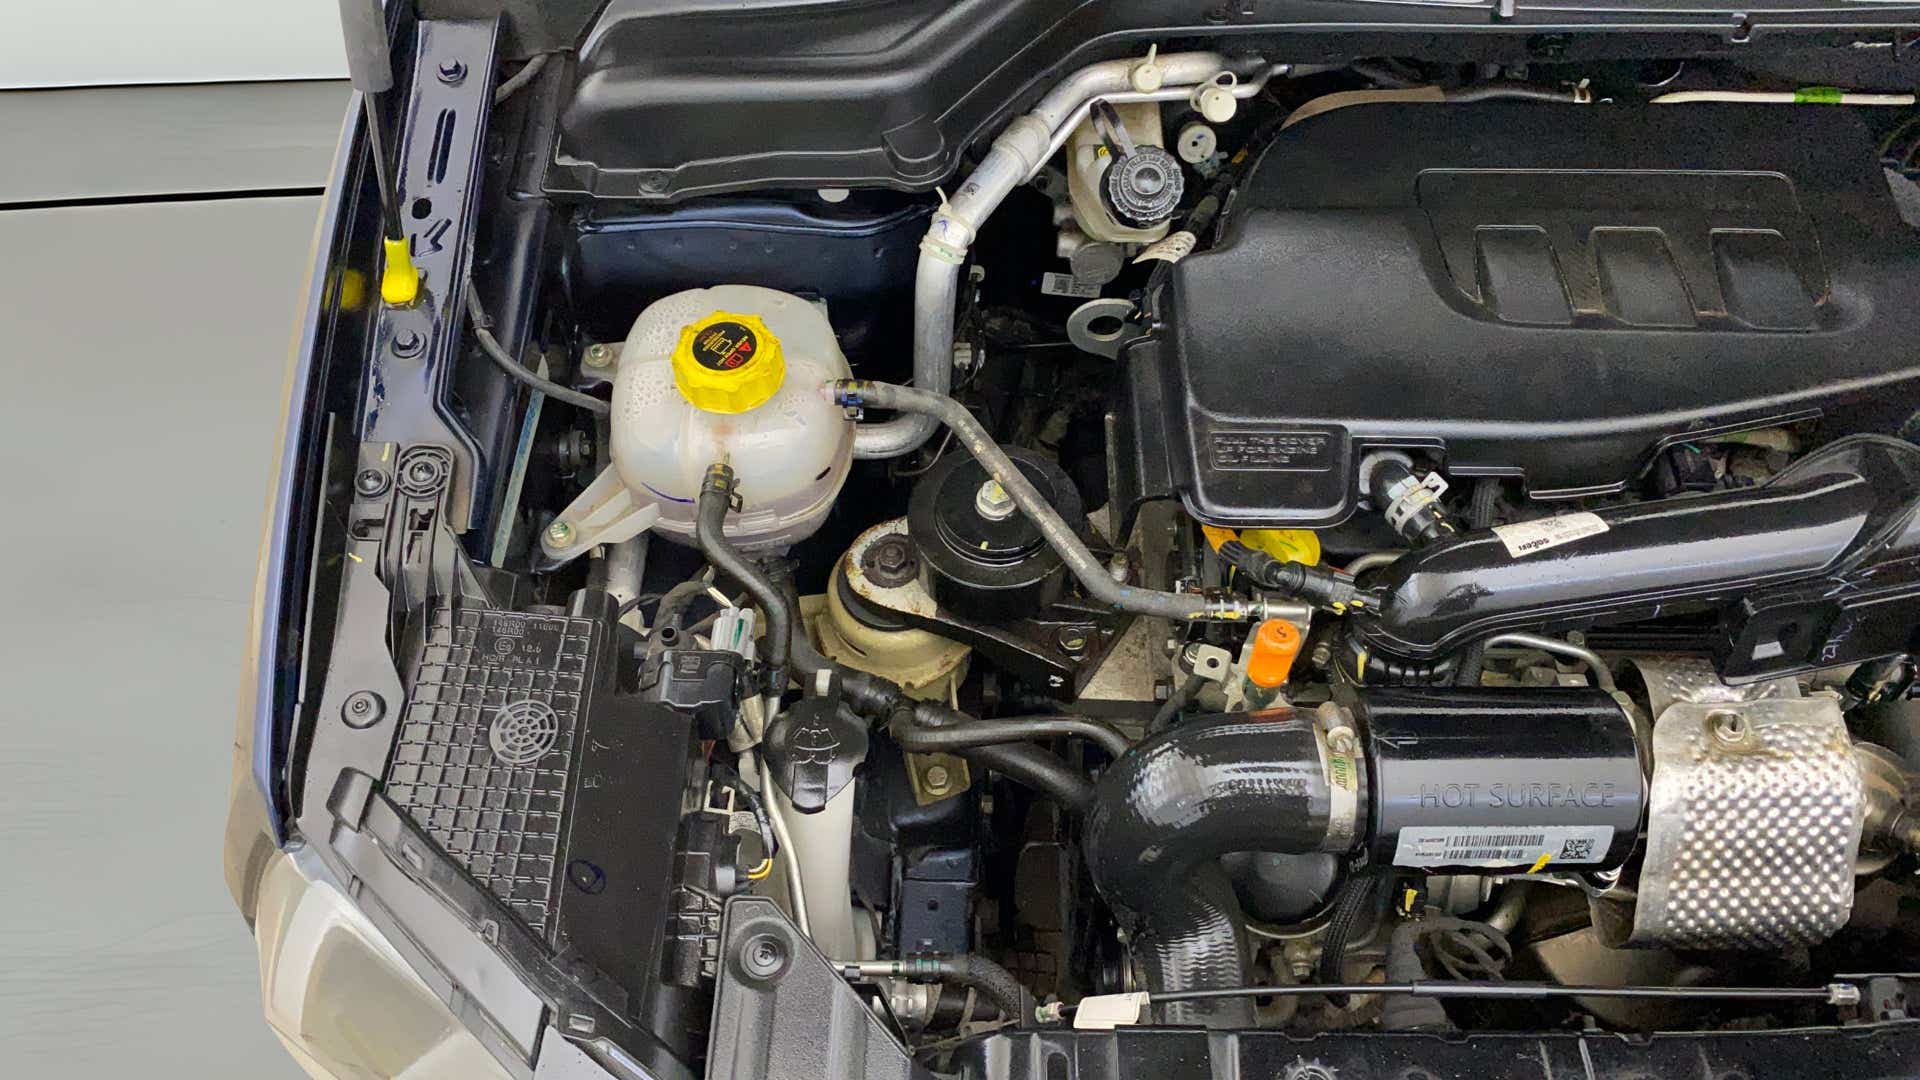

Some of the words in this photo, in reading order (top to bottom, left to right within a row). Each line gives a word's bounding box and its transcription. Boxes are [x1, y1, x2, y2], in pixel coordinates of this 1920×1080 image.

[1279, 436, 1327, 447] COVER
[1267, 446, 1319, 455] ENGINE
[1419, 782, 1480, 809] HOT
[1488, 782, 1616, 809] SURFACE
